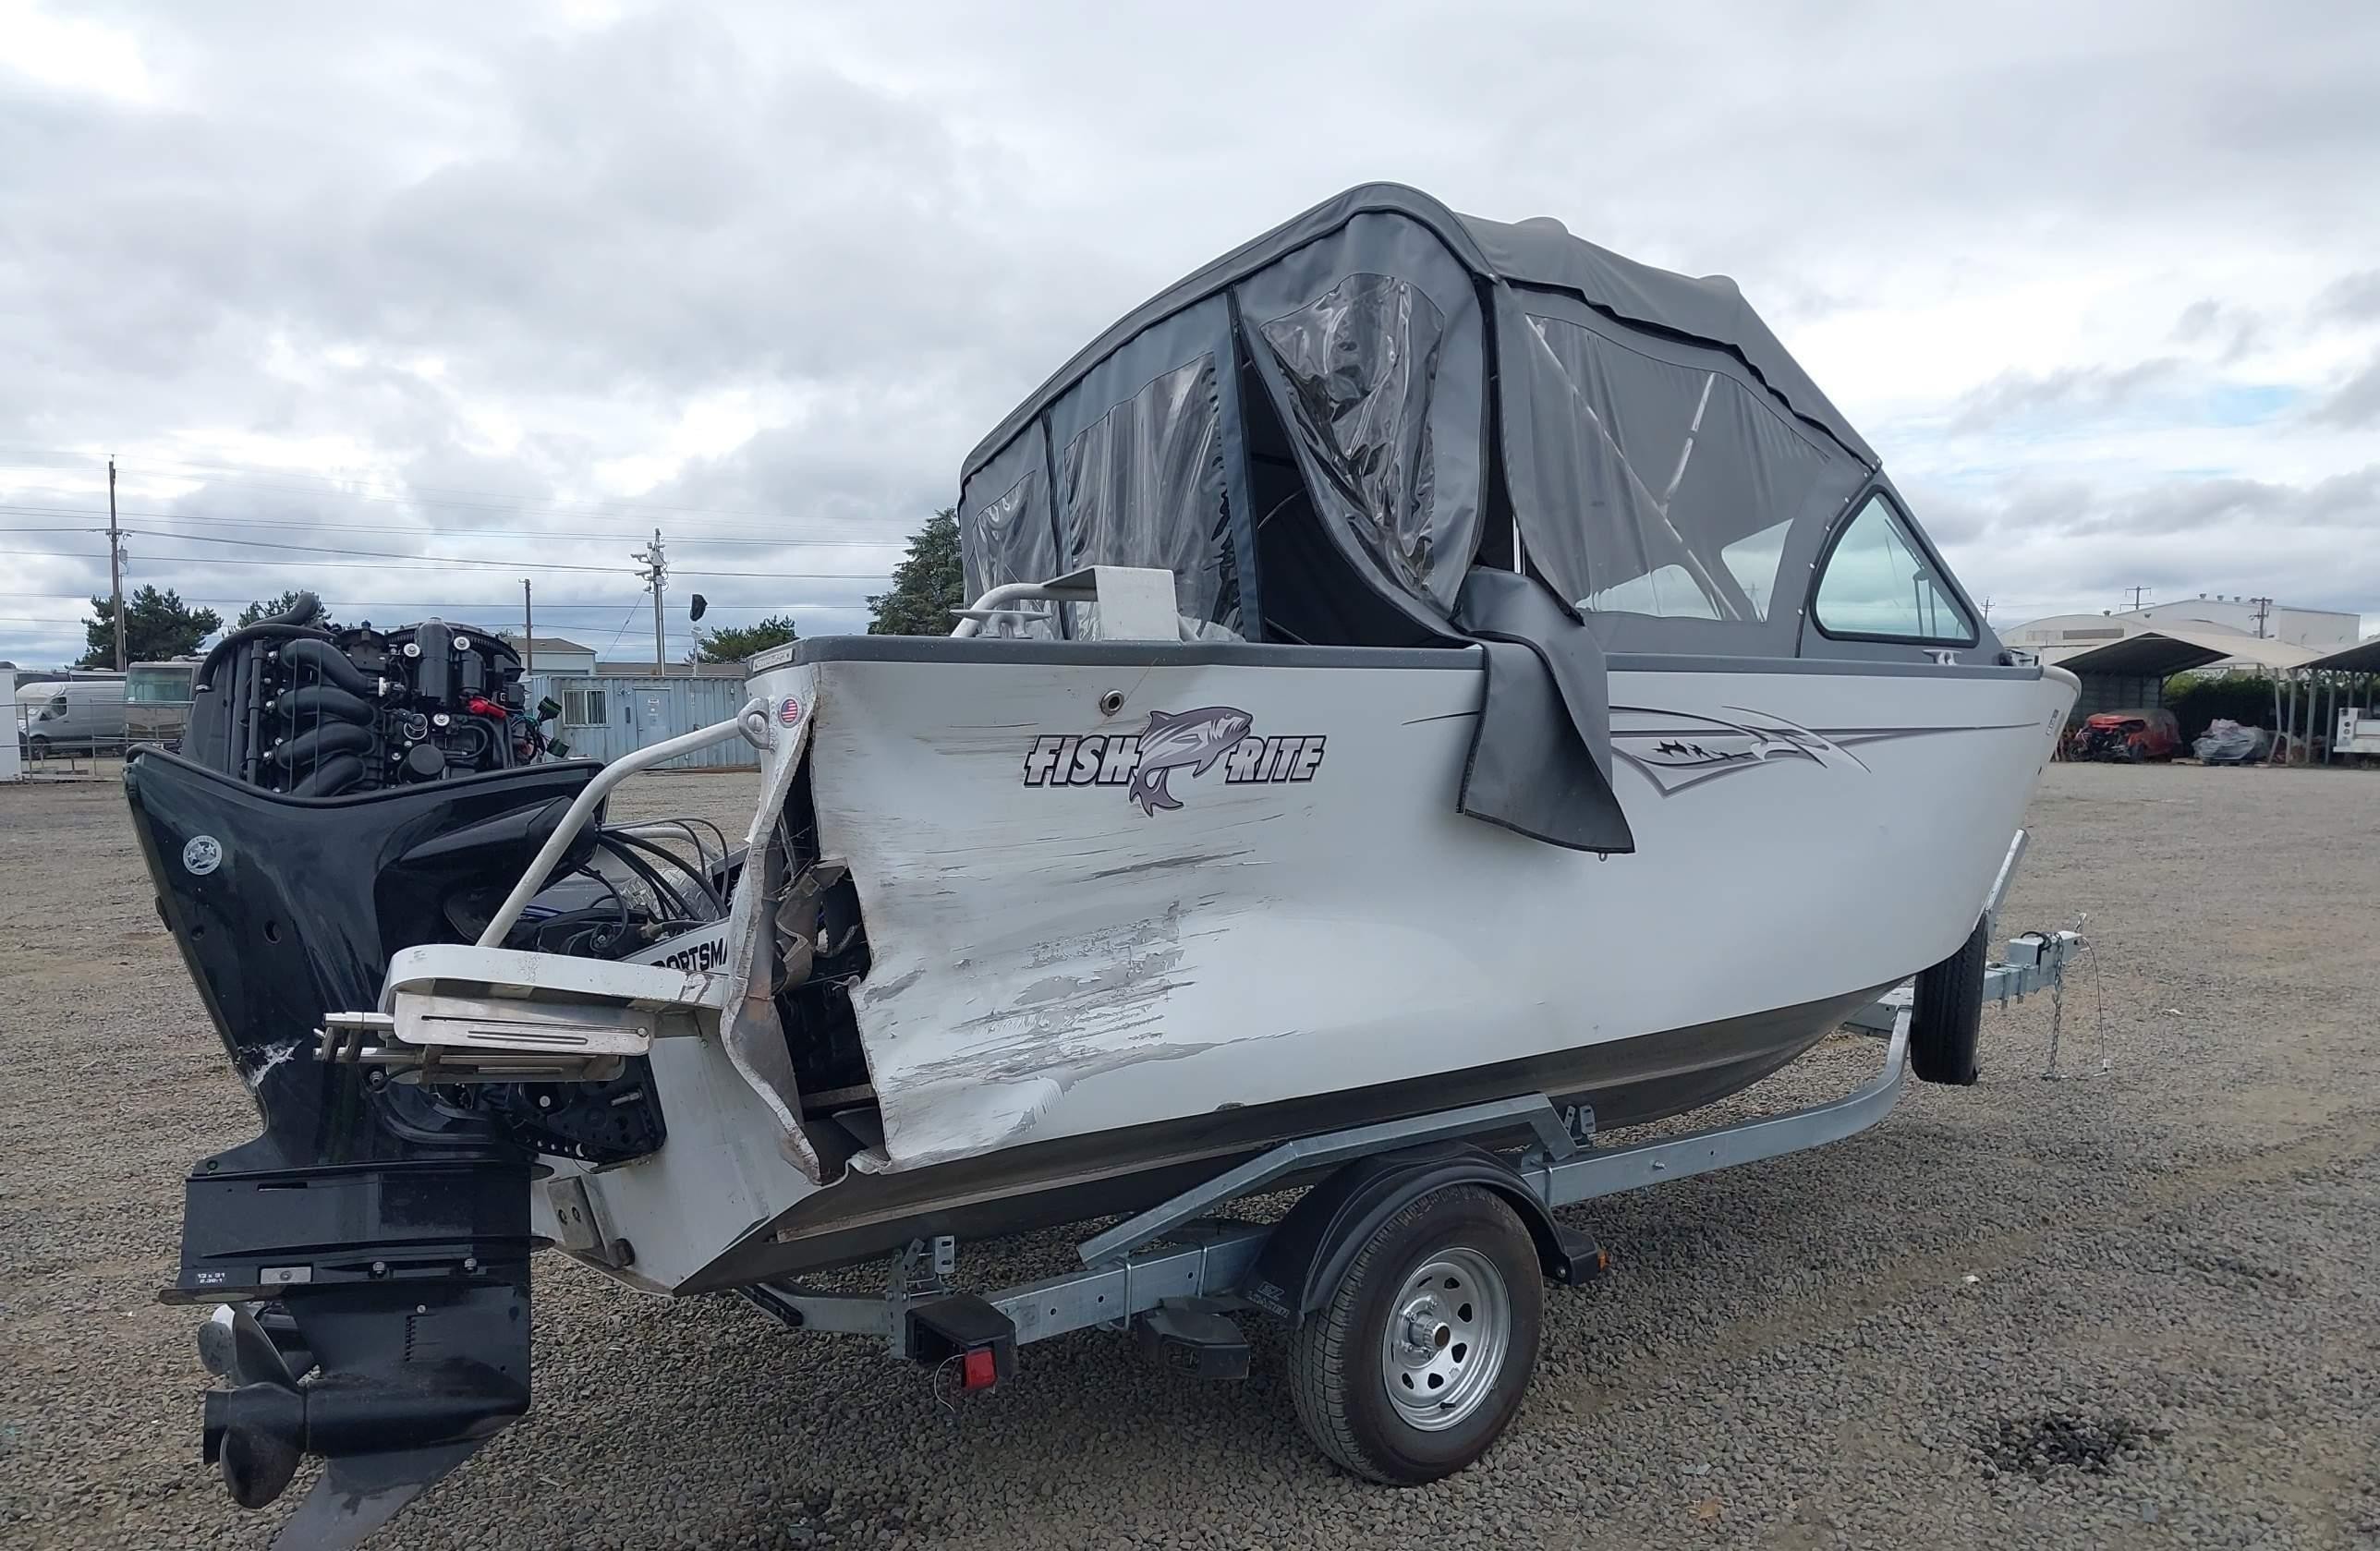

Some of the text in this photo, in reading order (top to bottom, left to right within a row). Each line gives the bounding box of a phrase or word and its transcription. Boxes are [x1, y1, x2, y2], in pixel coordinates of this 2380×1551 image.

[1024, 733, 1327, 787] FISH RITE
[650, 938, 728, 971] ORTSM
